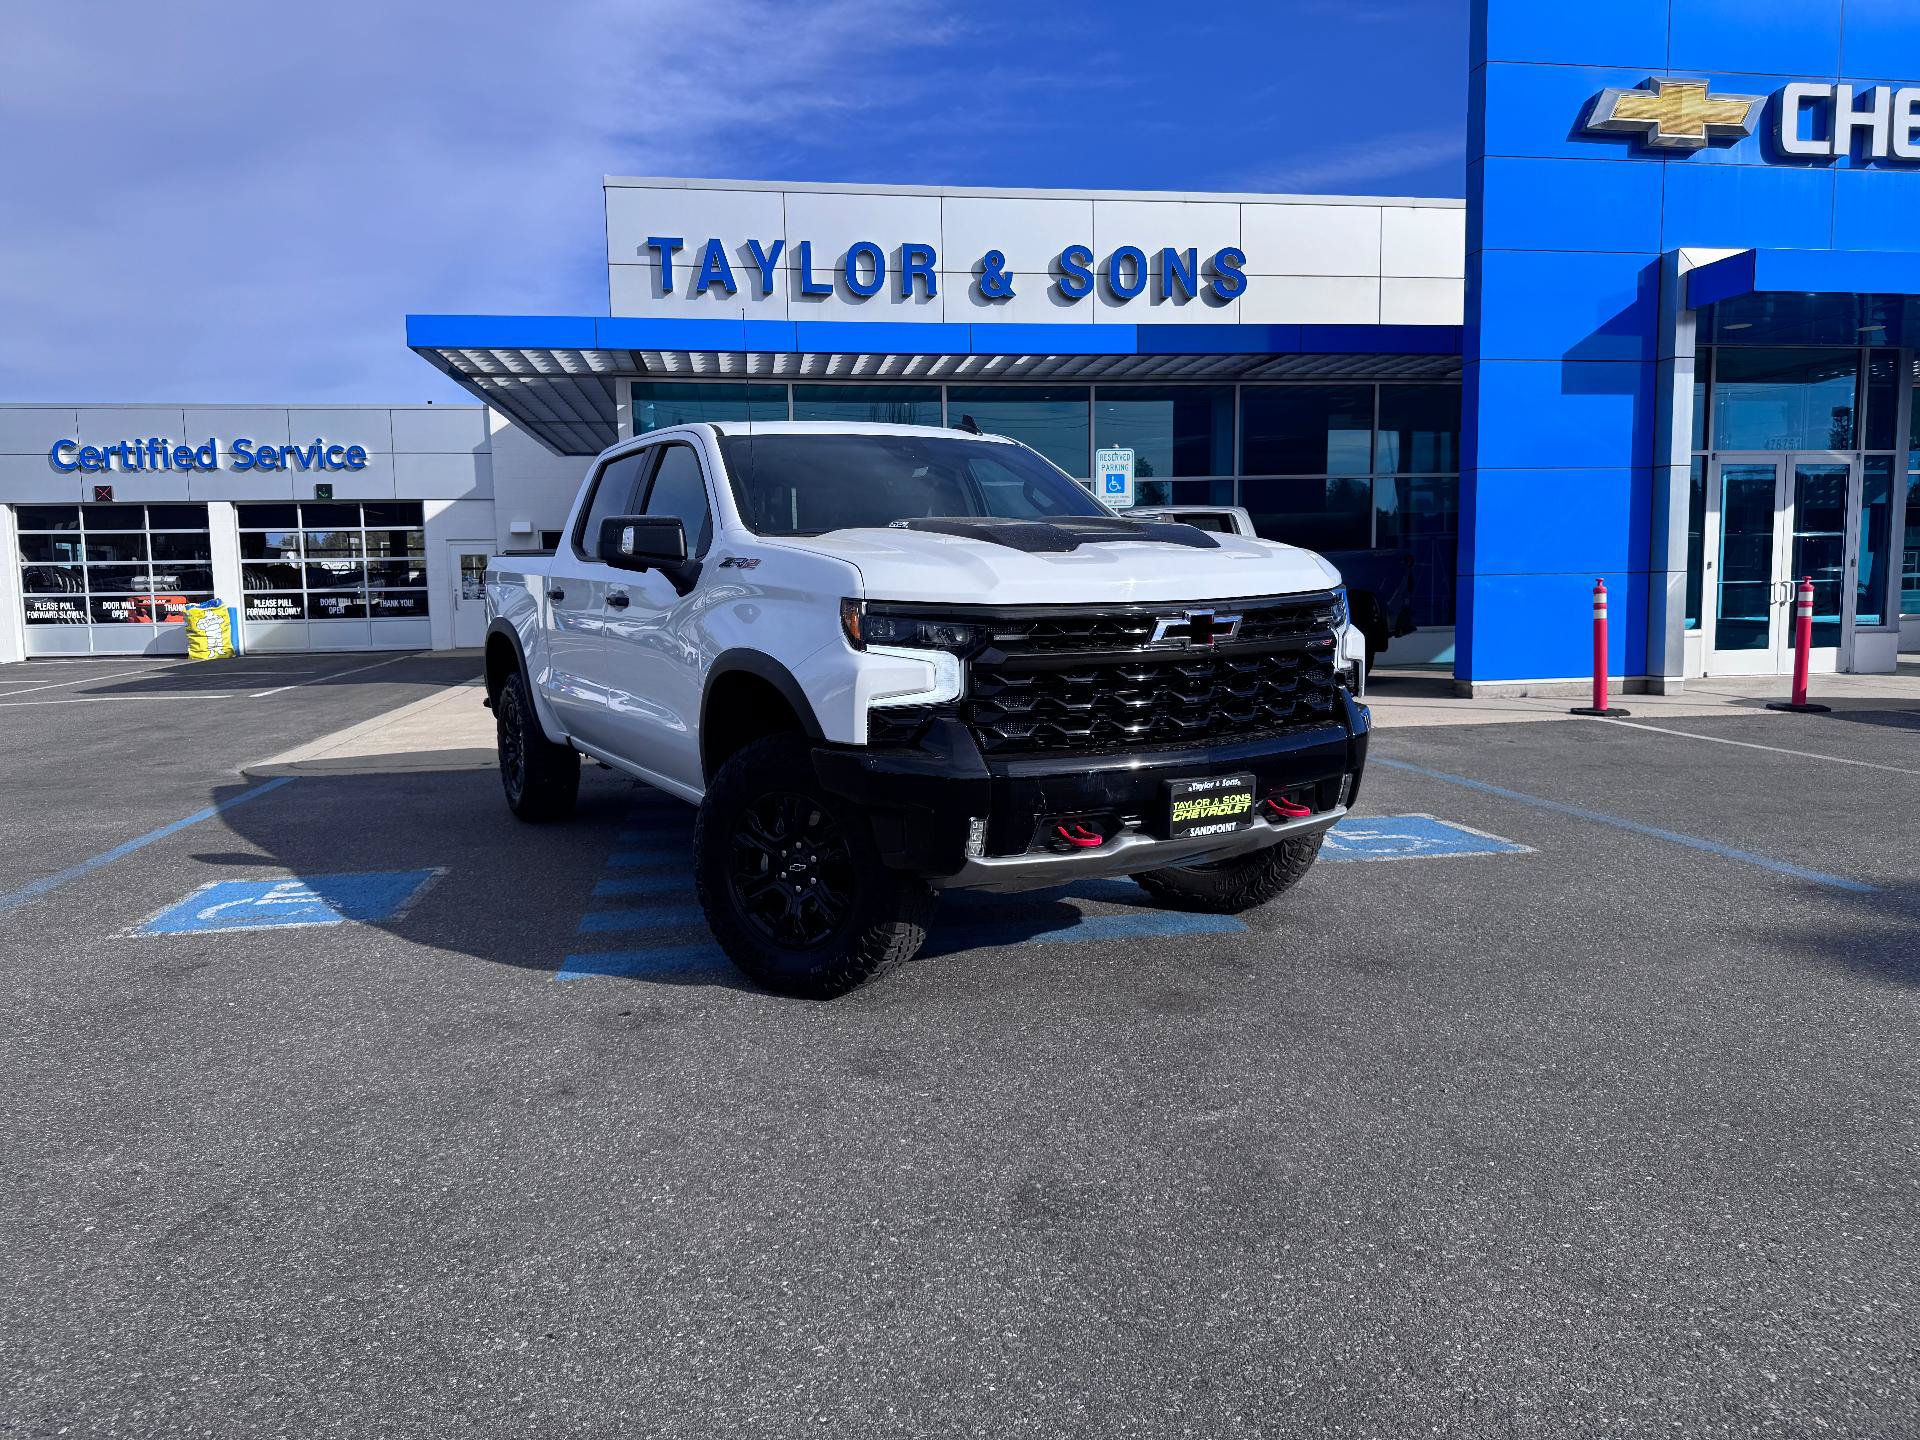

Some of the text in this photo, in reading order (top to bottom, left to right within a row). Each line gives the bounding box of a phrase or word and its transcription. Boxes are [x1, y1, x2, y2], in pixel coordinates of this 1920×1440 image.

[647, 236, 1247, 300] TAYLOR & SONS
[51, 437, 368, 471] Certified Service
[1099, 453, 1131, 462] RESERVED
[1101, 463, 1129, 472] PARKING
[34, 601, 76, 610] PLEASE PULL
[102, 601, 120, 610] DOOR
[121, 601, 137, 610] WILL
[253, 598, 293, 608] PLEASE PULL
[320, 597, 352, 606] DOOR WILL
[380, 598, 414, 608] THANK YOU!
[26, 610, 84, 619] FORWARD SLOWLY
[111, 610, 129, 618] OPEN
[246, 607, 302, 616] FORWARD SLOWLY
[328, 606, 345, 614] OPEN
[1192, 781, 1214, 791] Taylor
[1173, 793, 1251, 811] TAYLOR & SONS
[1173, 803, 1251, 822] CHEVROLET
[1189, 821, 1237, 837] SANDPOINT
